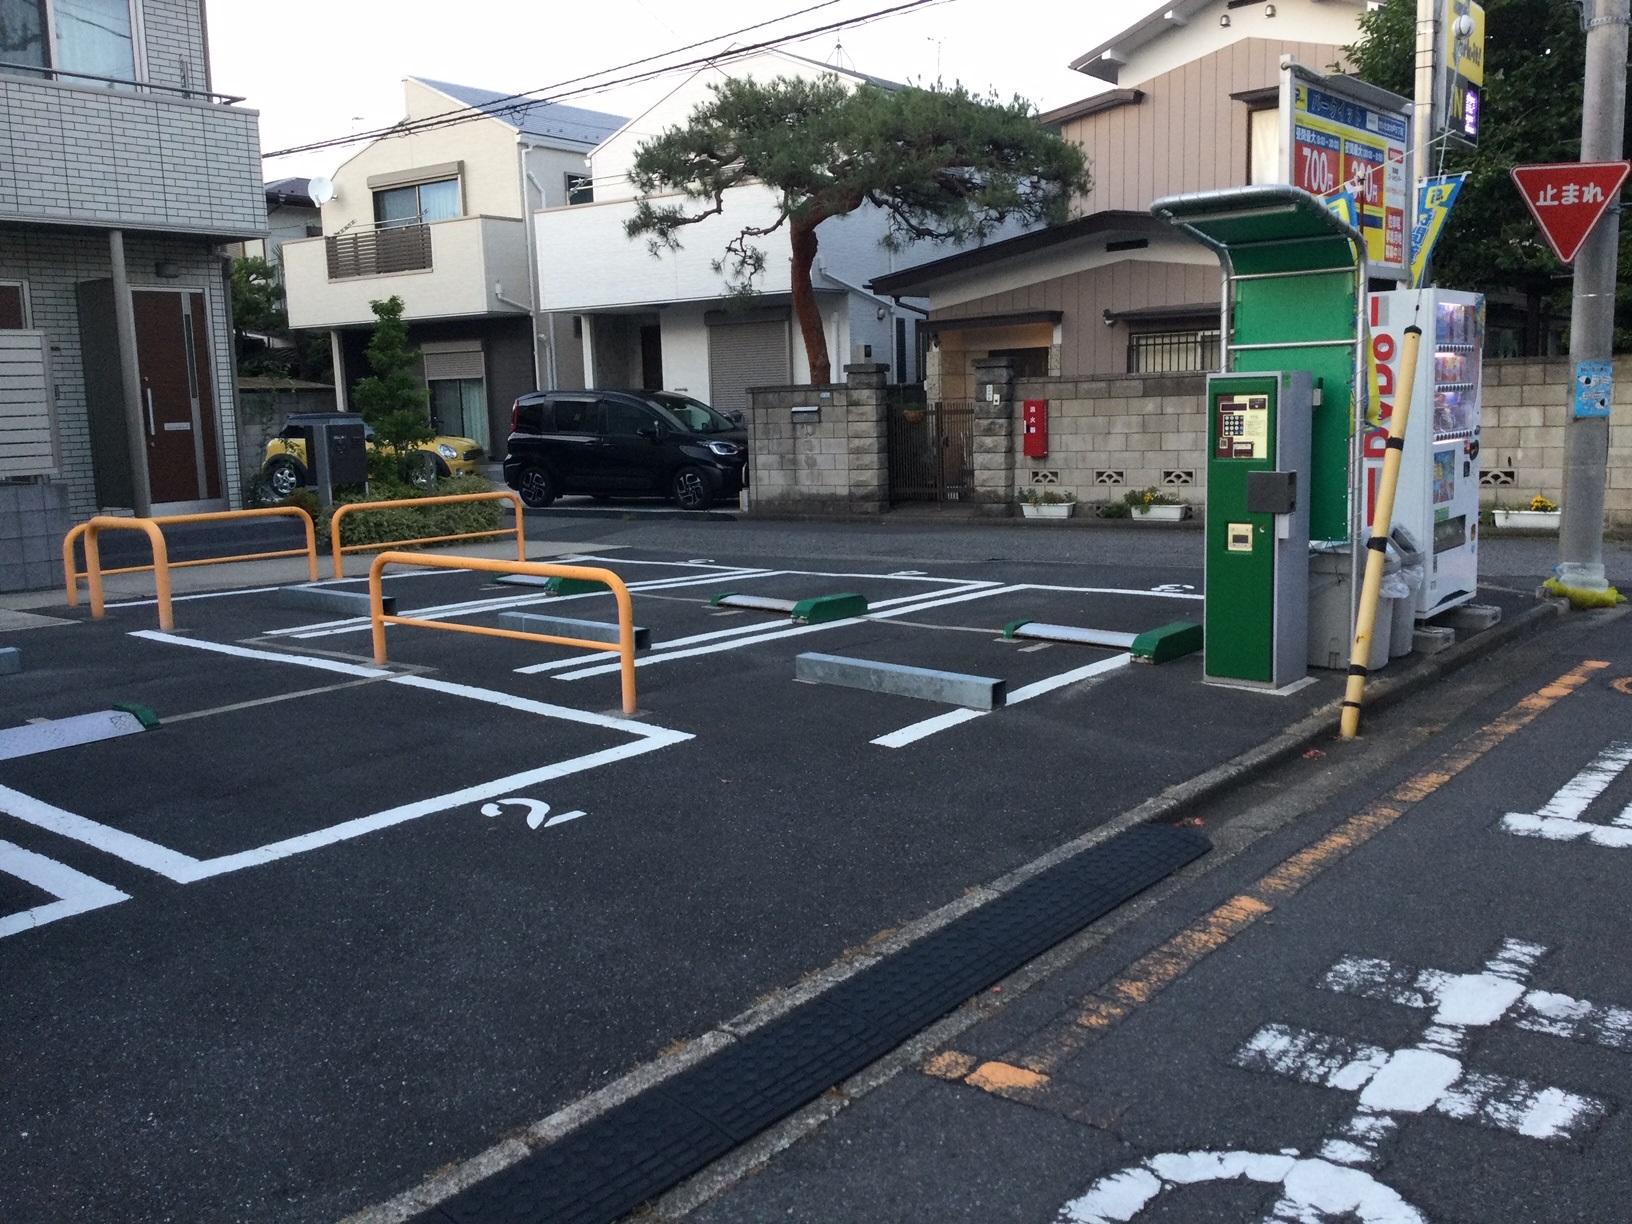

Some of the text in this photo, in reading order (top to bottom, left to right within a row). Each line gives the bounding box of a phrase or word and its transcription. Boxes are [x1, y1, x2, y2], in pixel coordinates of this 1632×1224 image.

[1535, 182, 1604, 206] 止まれ
[480, 797, 588, 830] 2
